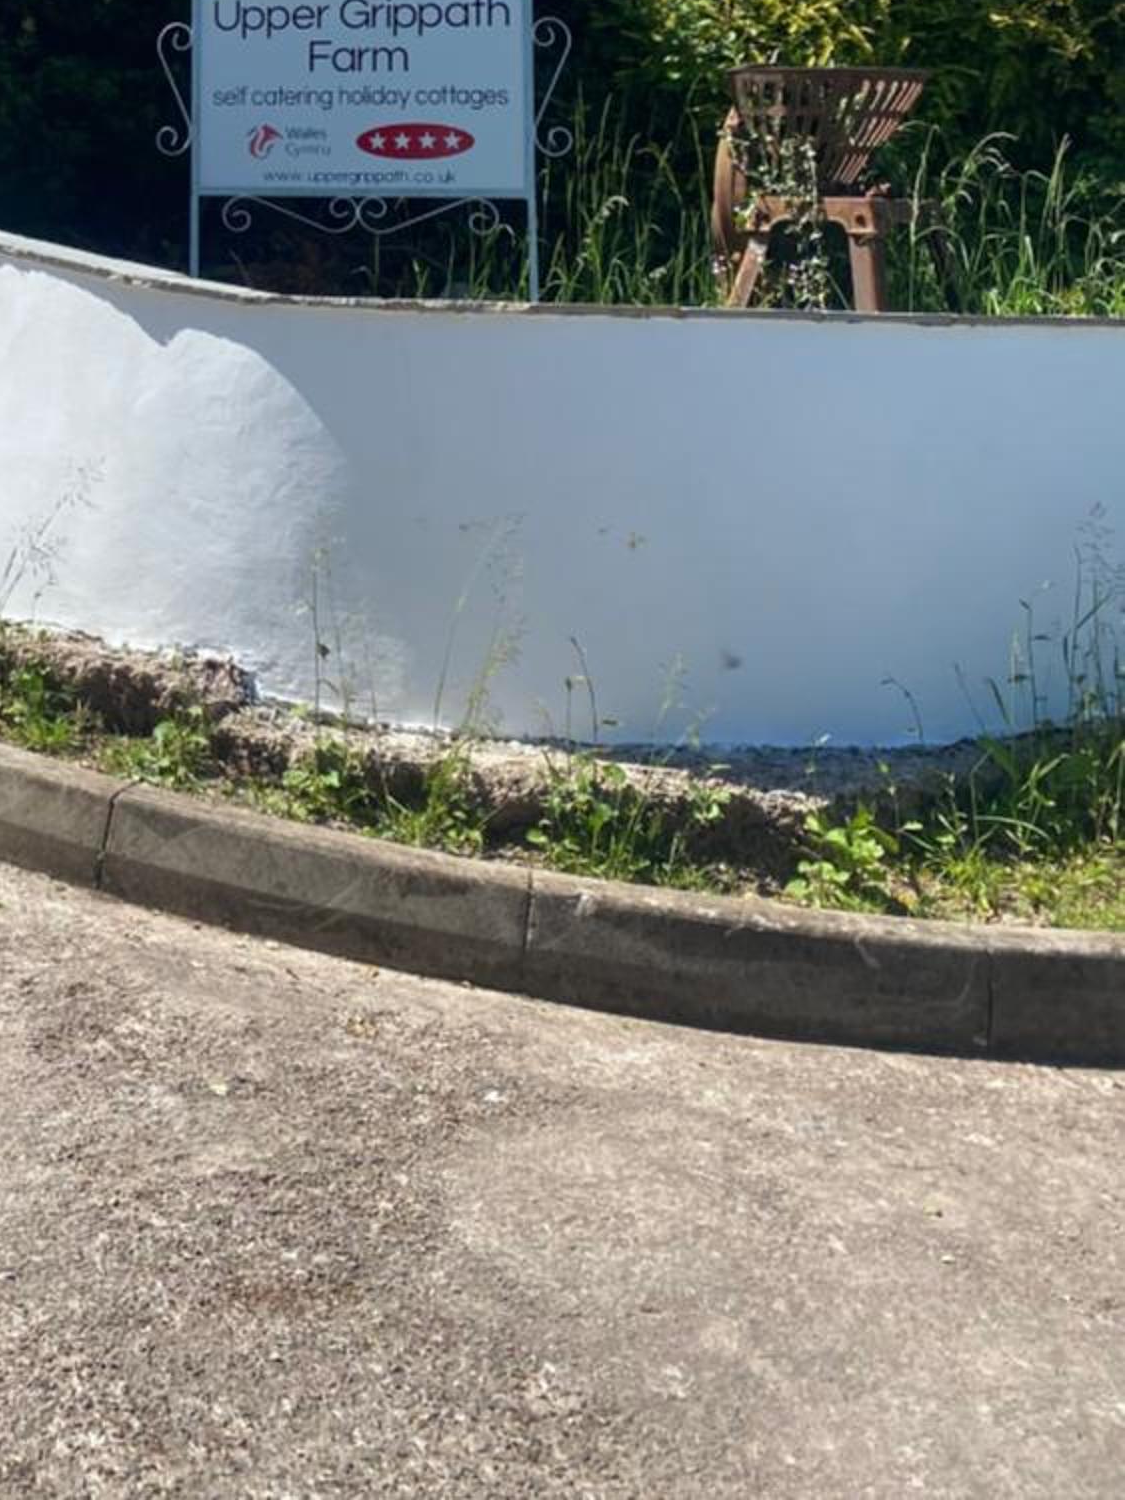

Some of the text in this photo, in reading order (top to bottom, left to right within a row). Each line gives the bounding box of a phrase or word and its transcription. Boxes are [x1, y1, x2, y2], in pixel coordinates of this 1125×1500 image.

[214, 0, 330, 39] Upper
[308, 40, 409, 73] Farm
[213, 83, 509, 111] self catering holiday cottages
[285, 125, 327, 140] Wales
